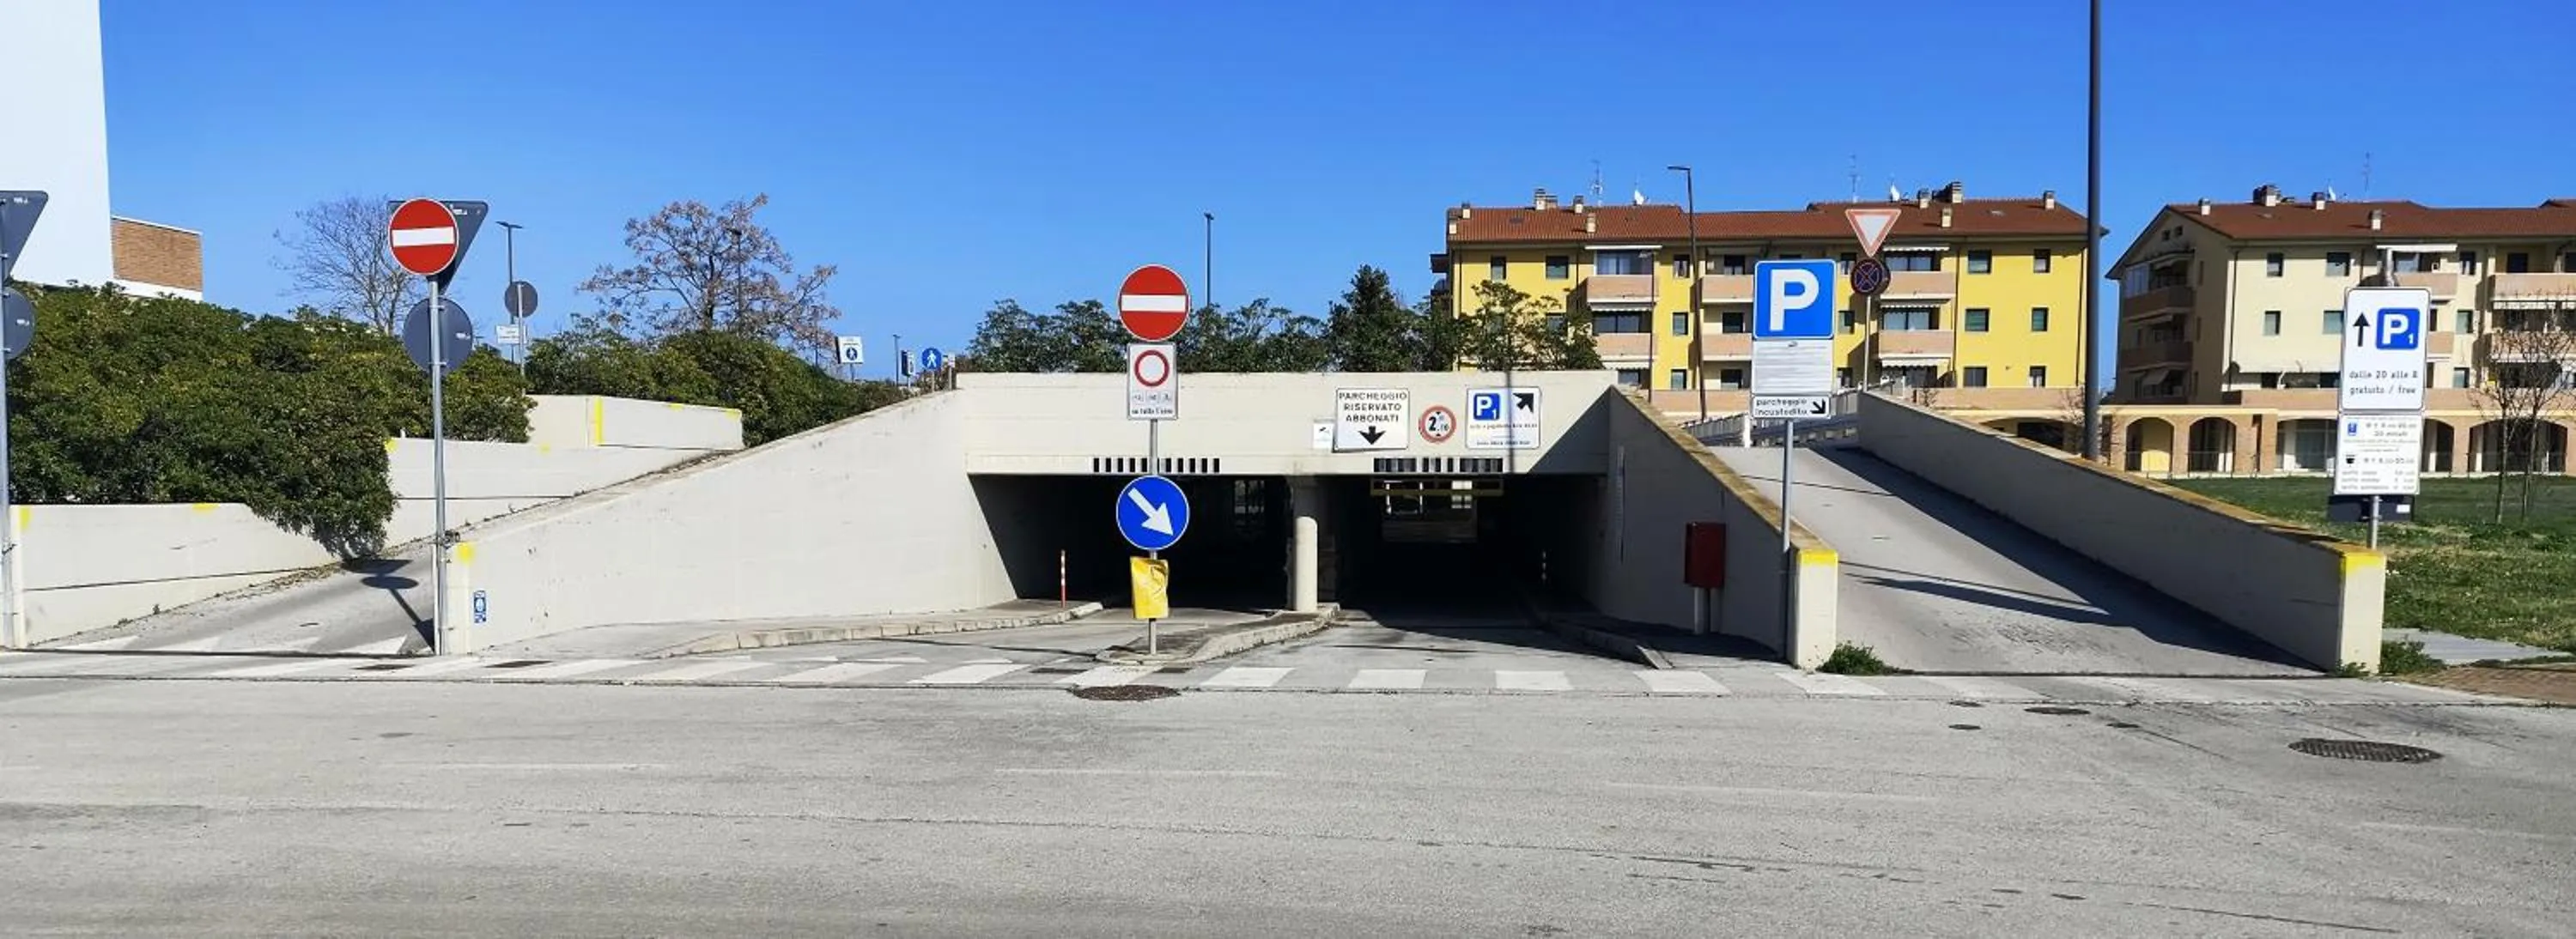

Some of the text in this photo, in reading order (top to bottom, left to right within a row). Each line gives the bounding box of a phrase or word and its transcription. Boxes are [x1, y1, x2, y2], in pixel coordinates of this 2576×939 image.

[1770, 269, 1820, 331] P
[2376, 370, 2387, 379] 20
[1339, 391, 1407, 401] PARCHEGGIO
[1344, 403, 1402, 411] RISERVATO
[1346, 414, 1399, 423] ABBONATI
